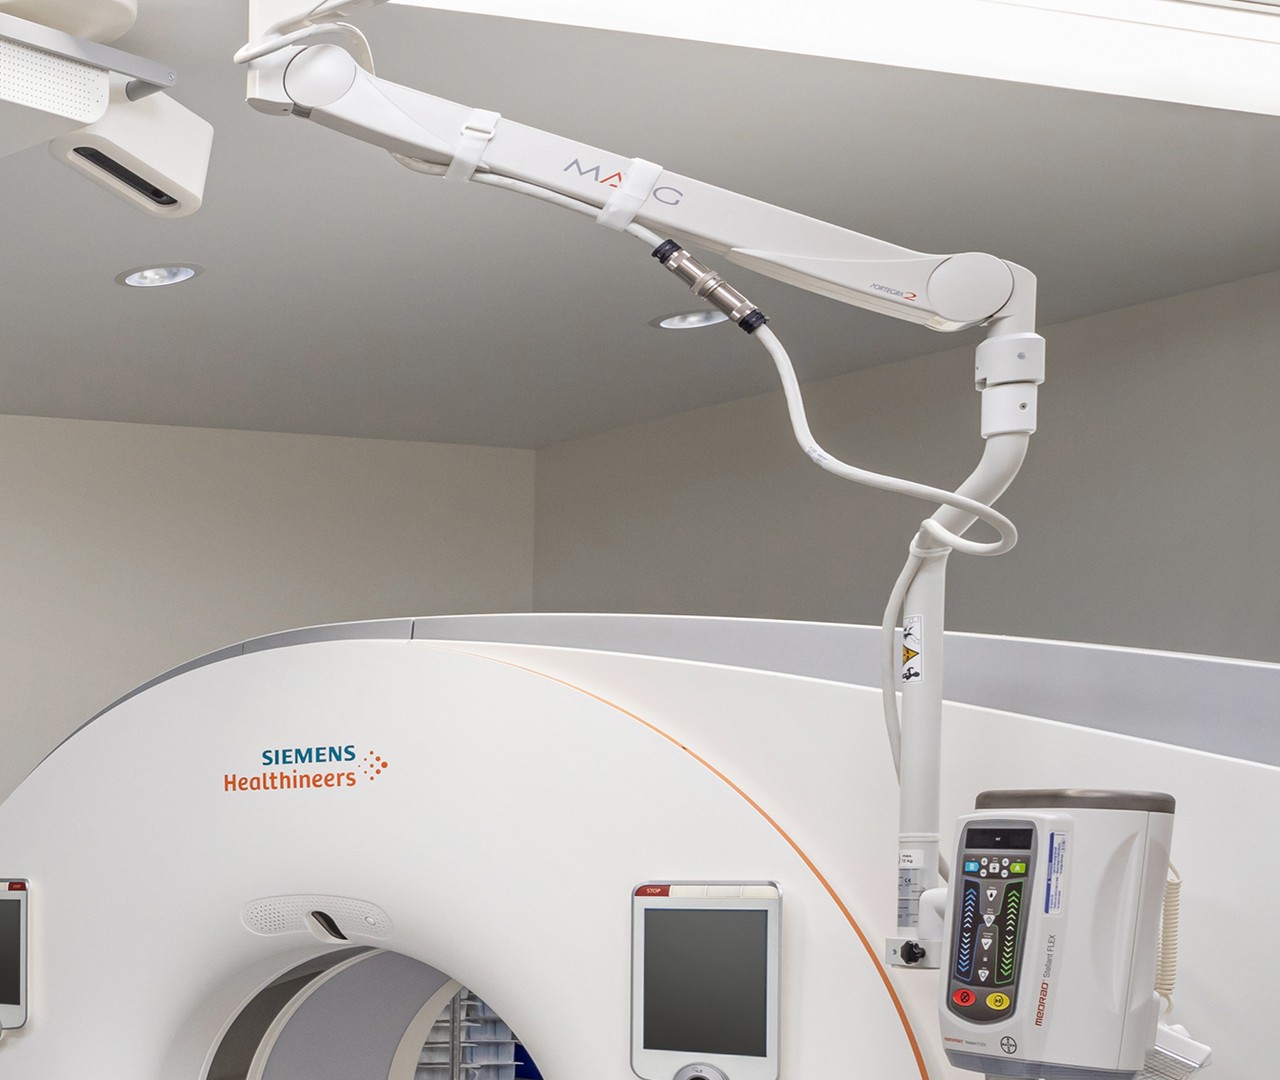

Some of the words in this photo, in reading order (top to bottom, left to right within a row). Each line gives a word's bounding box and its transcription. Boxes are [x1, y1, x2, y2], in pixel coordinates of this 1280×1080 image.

[563, 158, 684, 206] MAG
[261, 745, 356, 765] SIEMENS
[224, 769, 357, 792] Healthineers
[1047, 934, 1056, 952] FLEX
